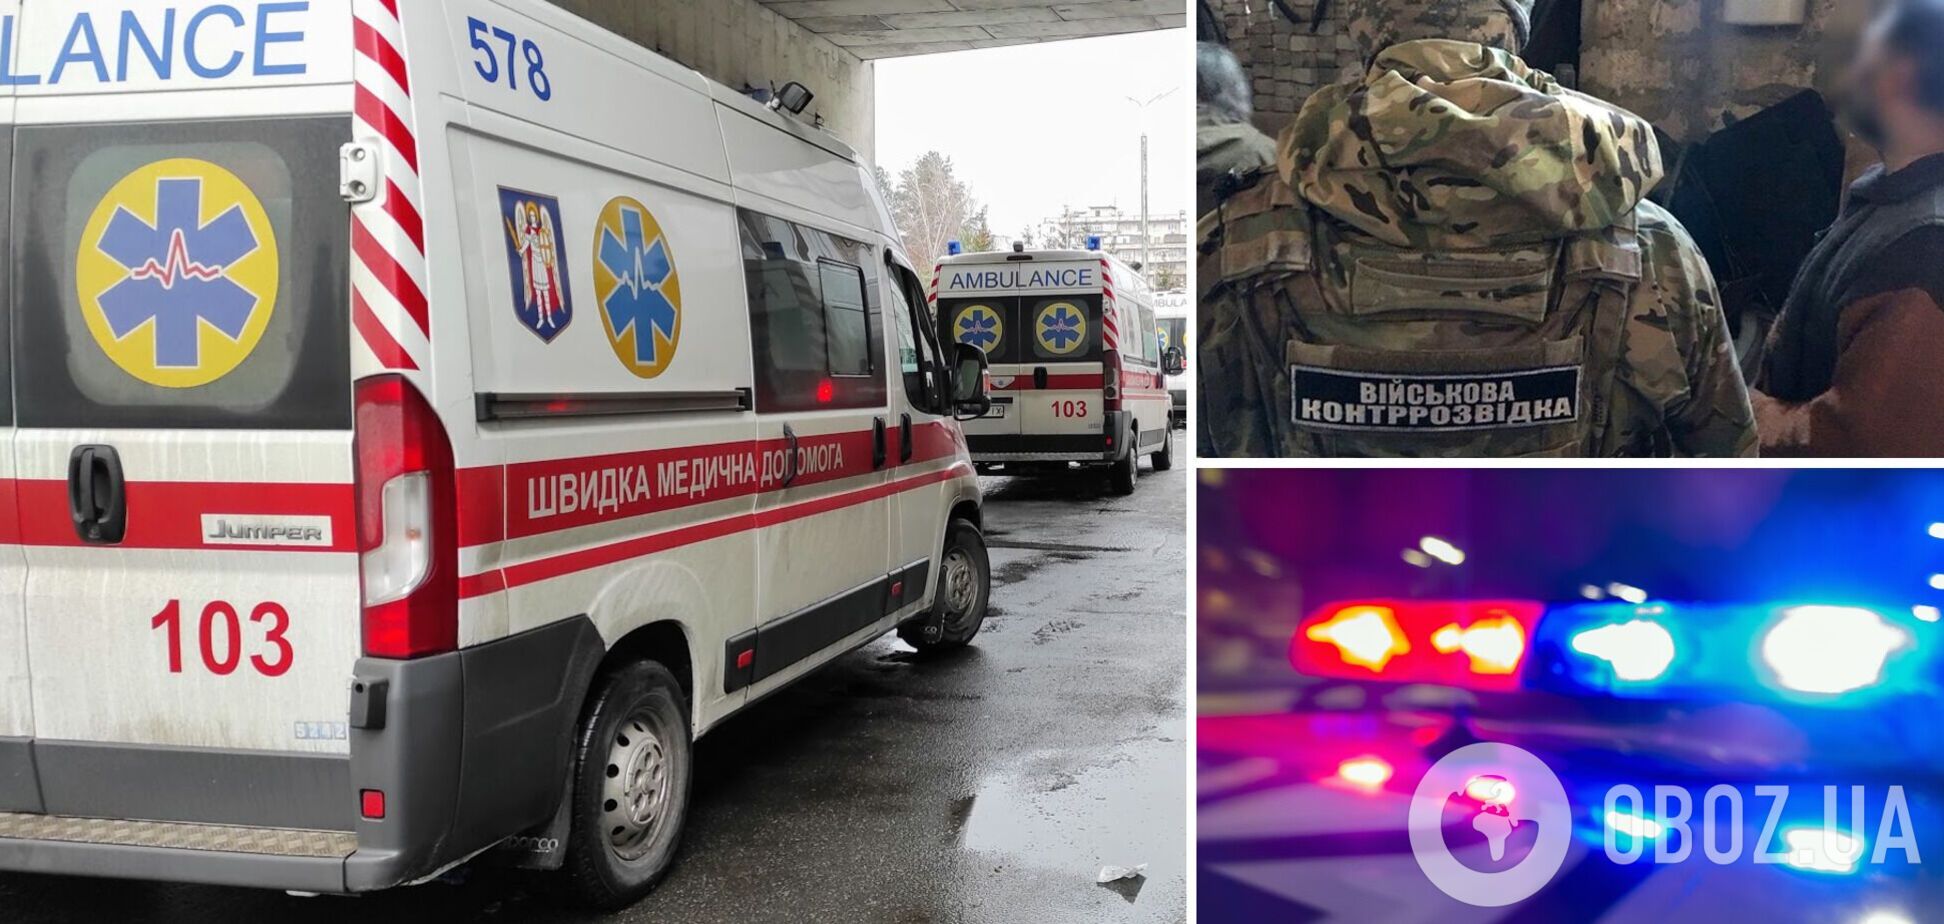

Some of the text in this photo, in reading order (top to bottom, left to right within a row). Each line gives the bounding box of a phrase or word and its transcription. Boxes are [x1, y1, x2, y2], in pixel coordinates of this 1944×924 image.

[0, 4, 309, 85] LANCE
[467, 16, 551, 102] 578
[950, 269, 1092, 289] AMBULANCE
[1051, 400, 1087, 418] 103
[1301, 397, 1572, 425] КОНТРРОЗВІДКА
[1360, 379, 1515, 405] ВІЙСЬКОВА
[528, 464, 651, 519] ШВИДКА
[657, 451, 757, 499] МЕДИЧНА
[150, 599, 294, 677] 103
